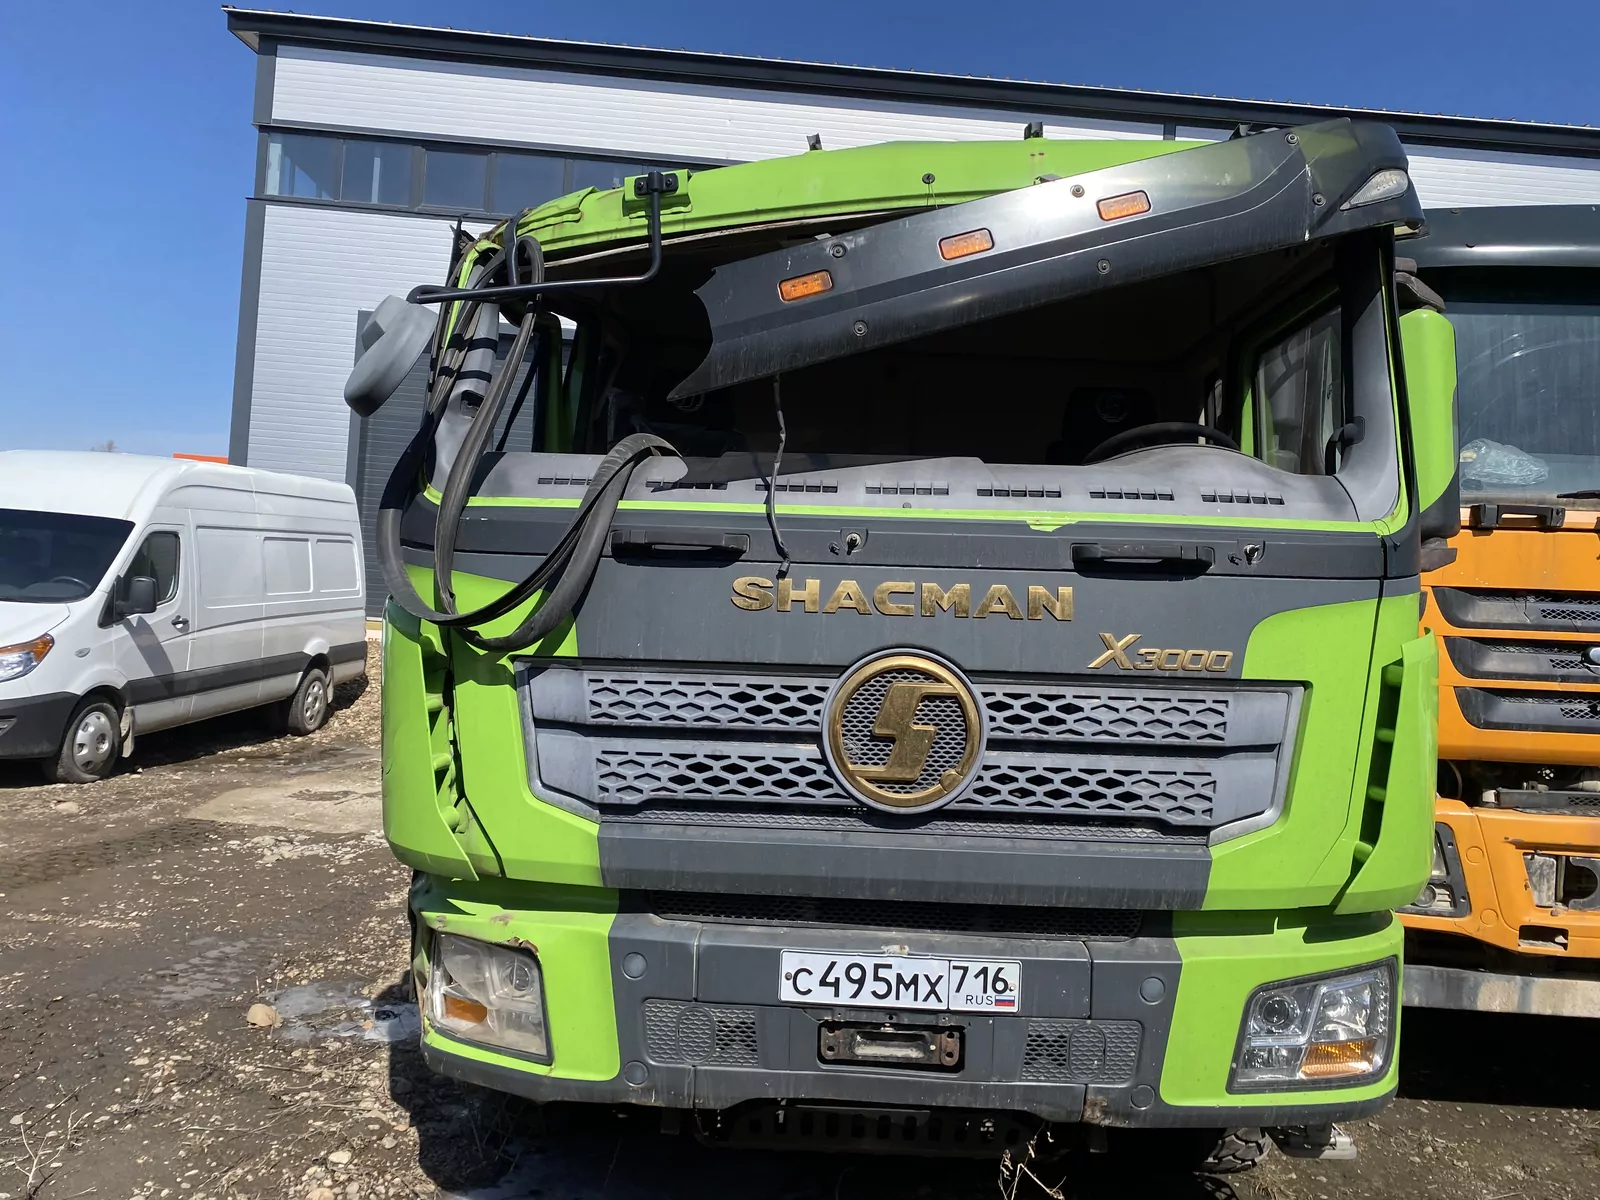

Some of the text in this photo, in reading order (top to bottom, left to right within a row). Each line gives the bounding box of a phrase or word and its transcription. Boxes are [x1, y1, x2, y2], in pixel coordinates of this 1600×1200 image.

[731, 577, 1074, 622] SHACMAN
[1086, 632, 1234, 672] X3000
[952, 965, 1009, 994] 716
[965, 995, 993, 1006] RUS
